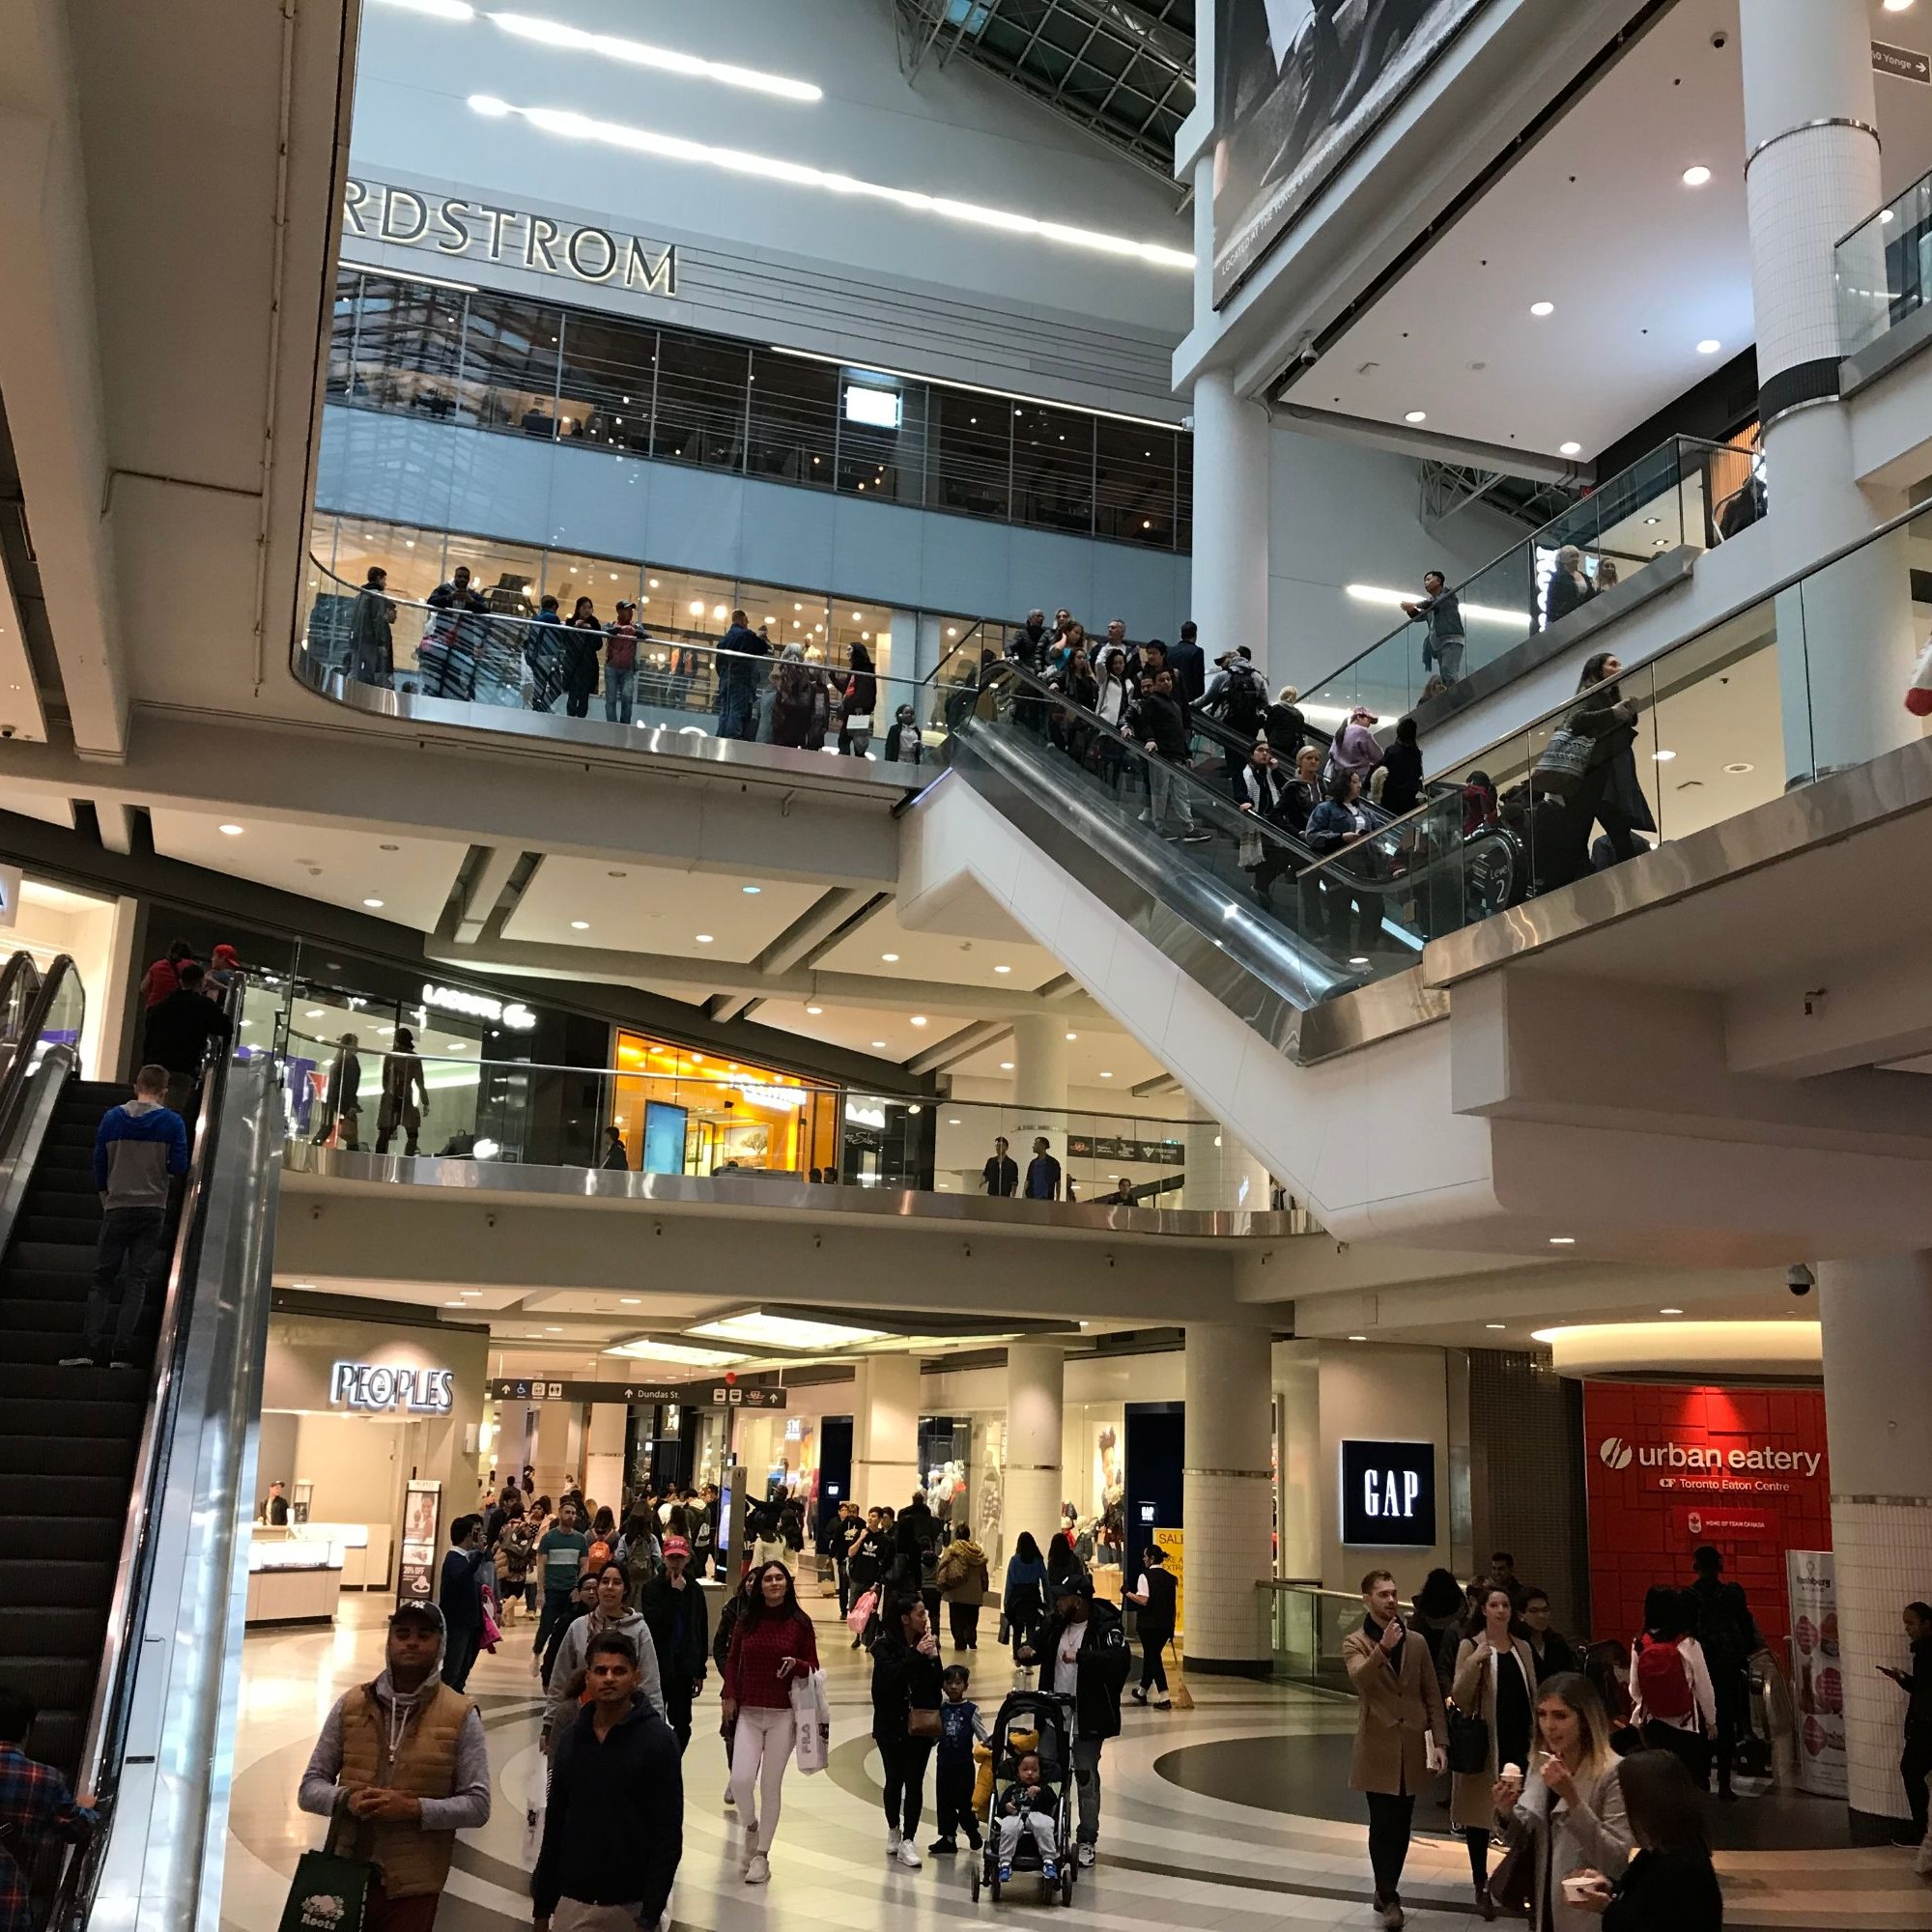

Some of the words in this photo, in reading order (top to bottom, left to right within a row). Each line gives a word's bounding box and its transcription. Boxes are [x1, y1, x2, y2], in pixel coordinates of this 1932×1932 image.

[1883, 54, 1912, 70] Yonge
[1495, 879, 1506, 904] 2
[331, 1363, 454, 1408] PEOPLES
[638, 1390, 668, 1399] Dundas
[1639, 1443, 1721, 1467] urban
[1727, 1446, 1821, 1477] eatery
[1364, 1468, 1418, 1518] GAP
[1679, 1478, 1719, 1490] Toronto
[1721, 1480, 1752, 1491] Eaton
[1754, 1481, 1790, 1492] Centre
[300, 1913, 337, 1931] Roots
